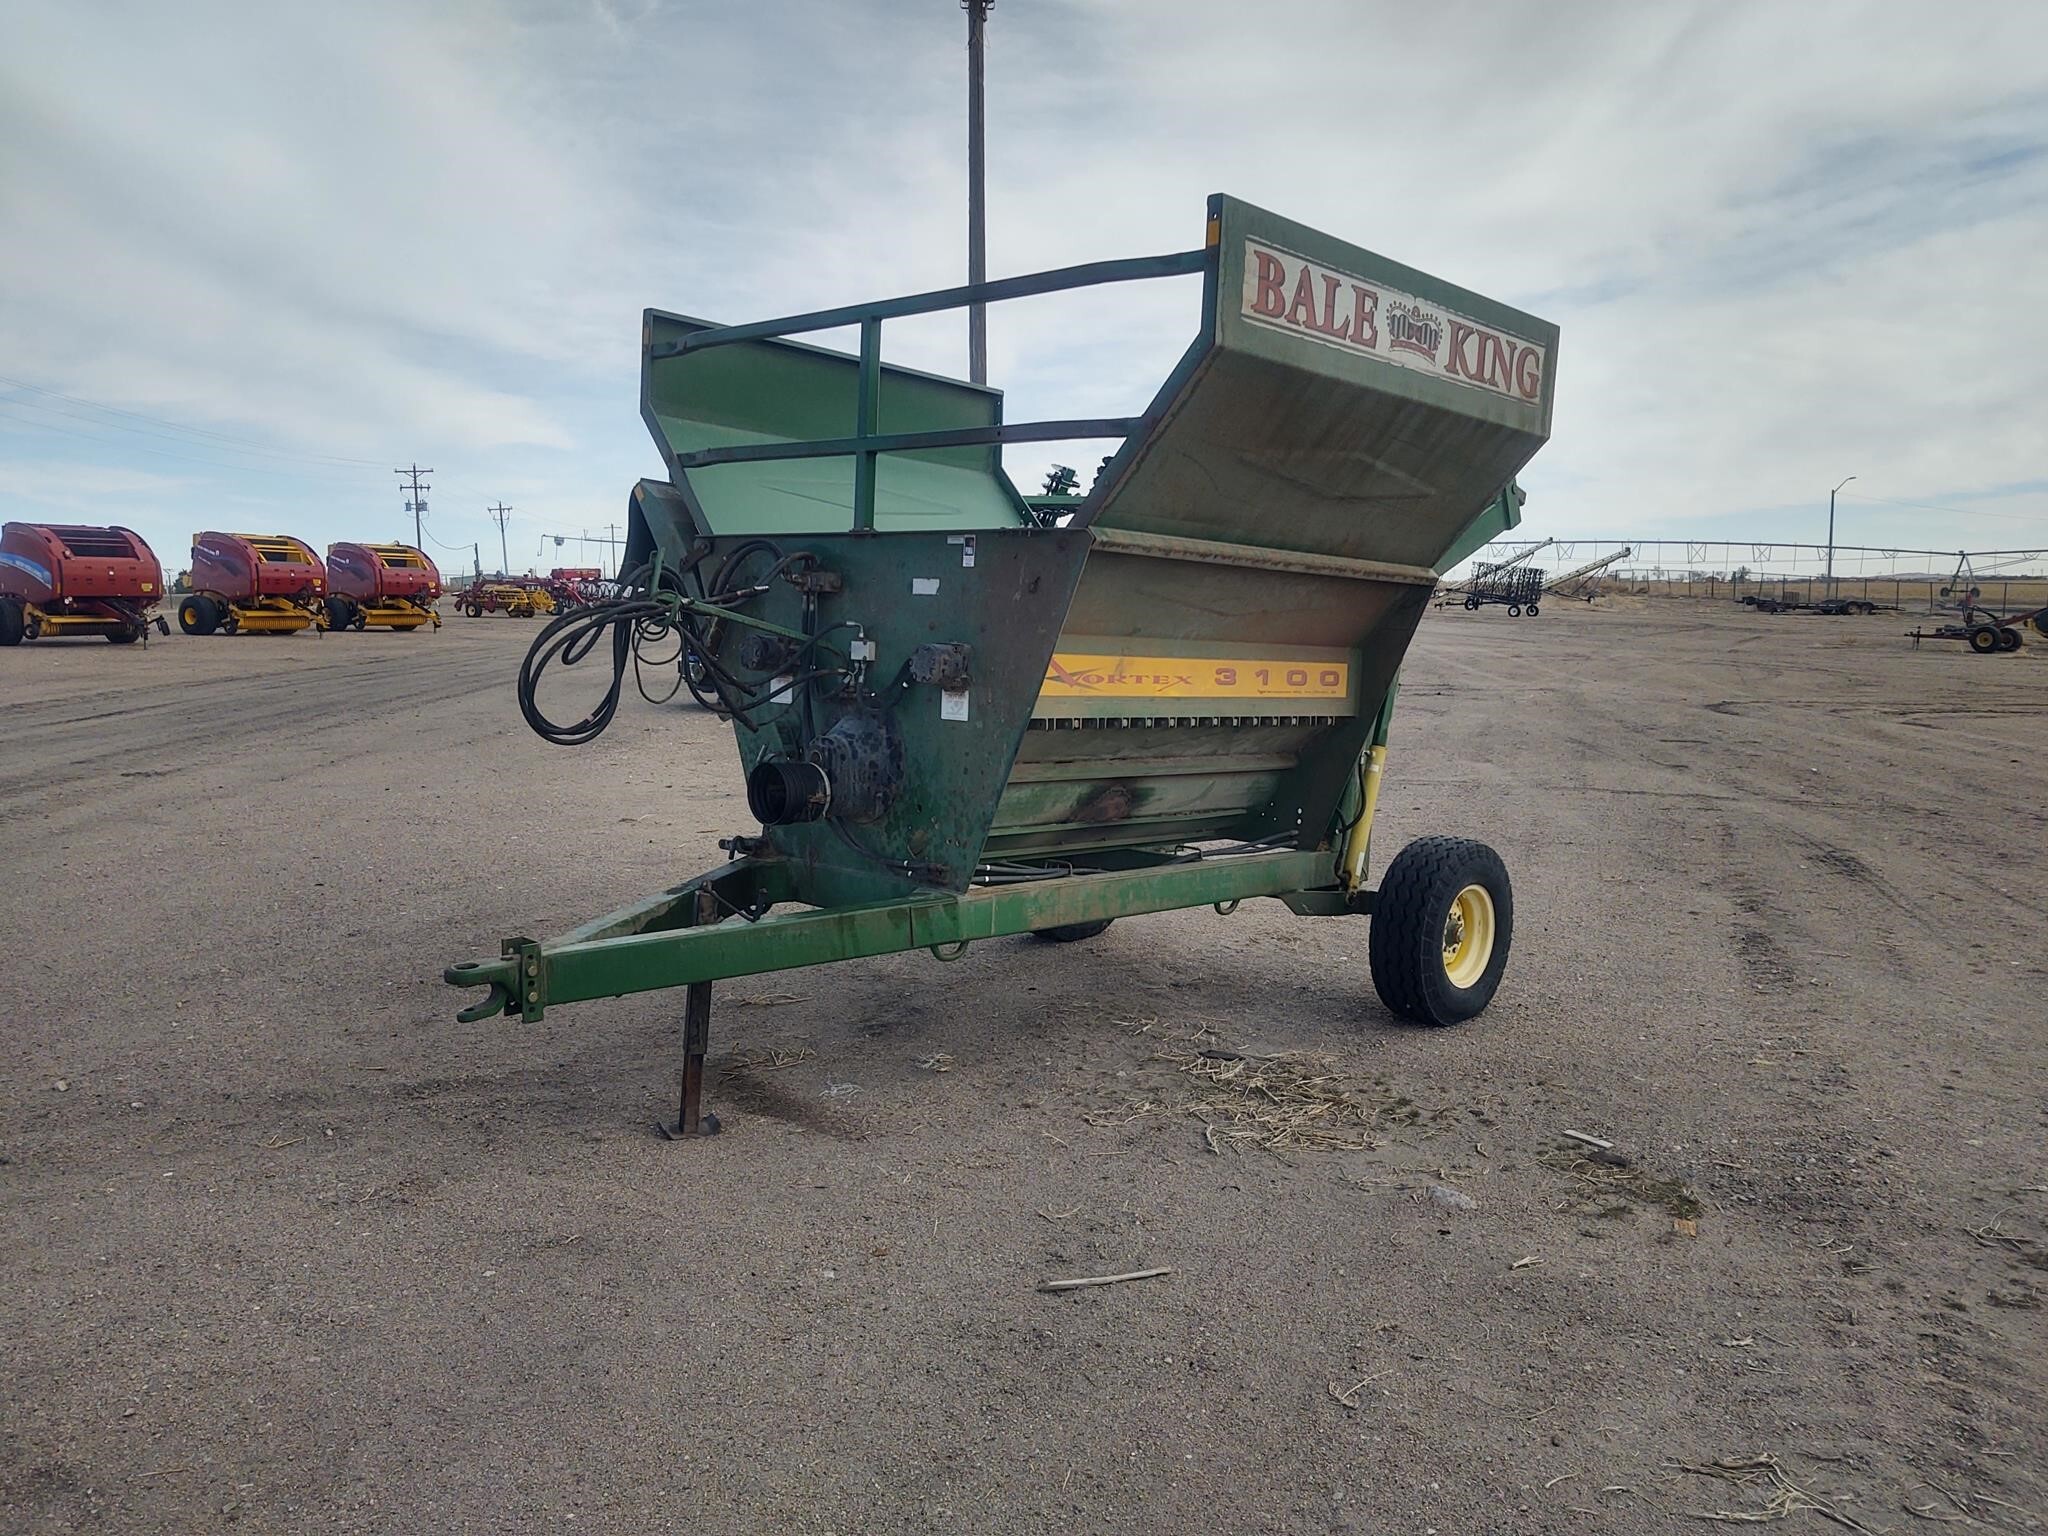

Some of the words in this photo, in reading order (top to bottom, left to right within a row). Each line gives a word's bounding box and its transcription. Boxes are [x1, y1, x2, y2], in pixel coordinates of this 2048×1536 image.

[1250, 249, 1379, 350] BALE
[1445, 318, 1540, 399] KING
[1215, 667, 1340, 687] 3100
